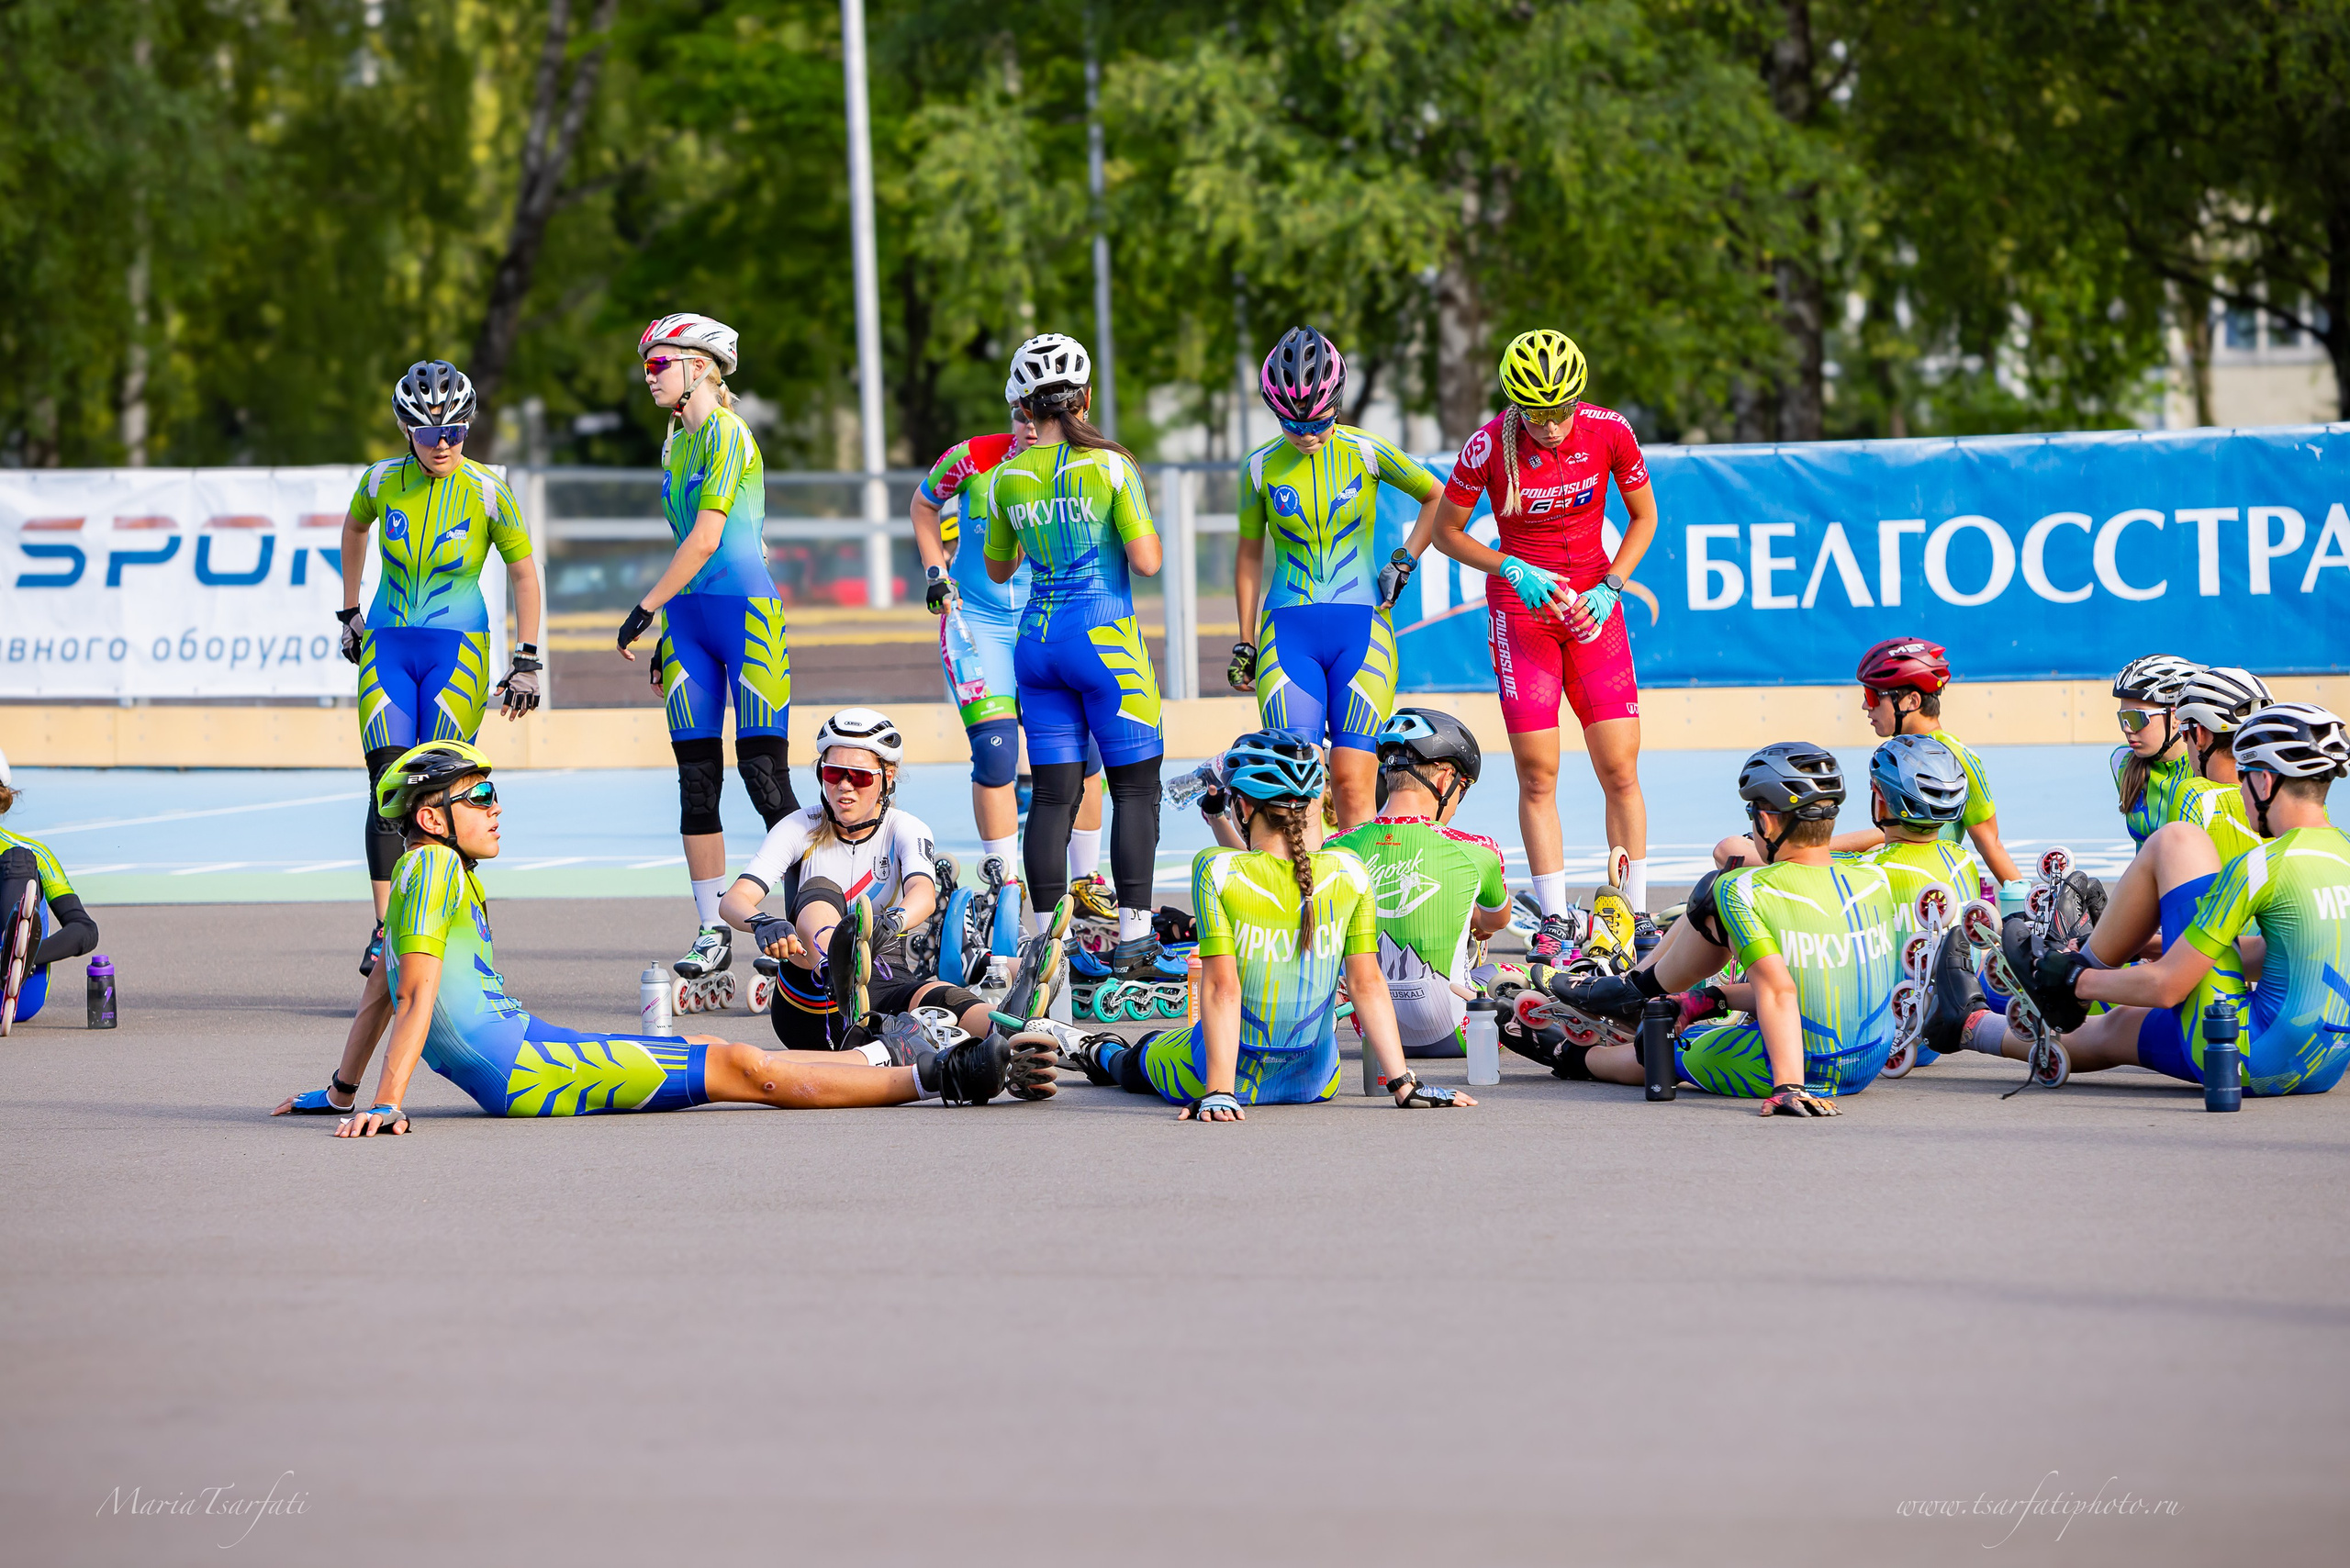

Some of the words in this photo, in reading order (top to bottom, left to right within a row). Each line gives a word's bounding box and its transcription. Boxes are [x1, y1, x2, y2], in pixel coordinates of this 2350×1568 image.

[1520, 473, 1599, 498] POWERSLIDE
[1007, 497, 1099, 531] ИРКУТСК
[1686, 502, 2350, 612] БЕЛГОССТРА
[0, 637, 128, 662] вного
[153, 628, 344, 669] оборудо
[1496, 610, 1518, 700] POWERSLIDE
[1888, 644, 1925, 657] MET
[1235, 917, 1344, 963] ИРКУСК
[1780, 921, 1893, 969] ИРКУТСК
